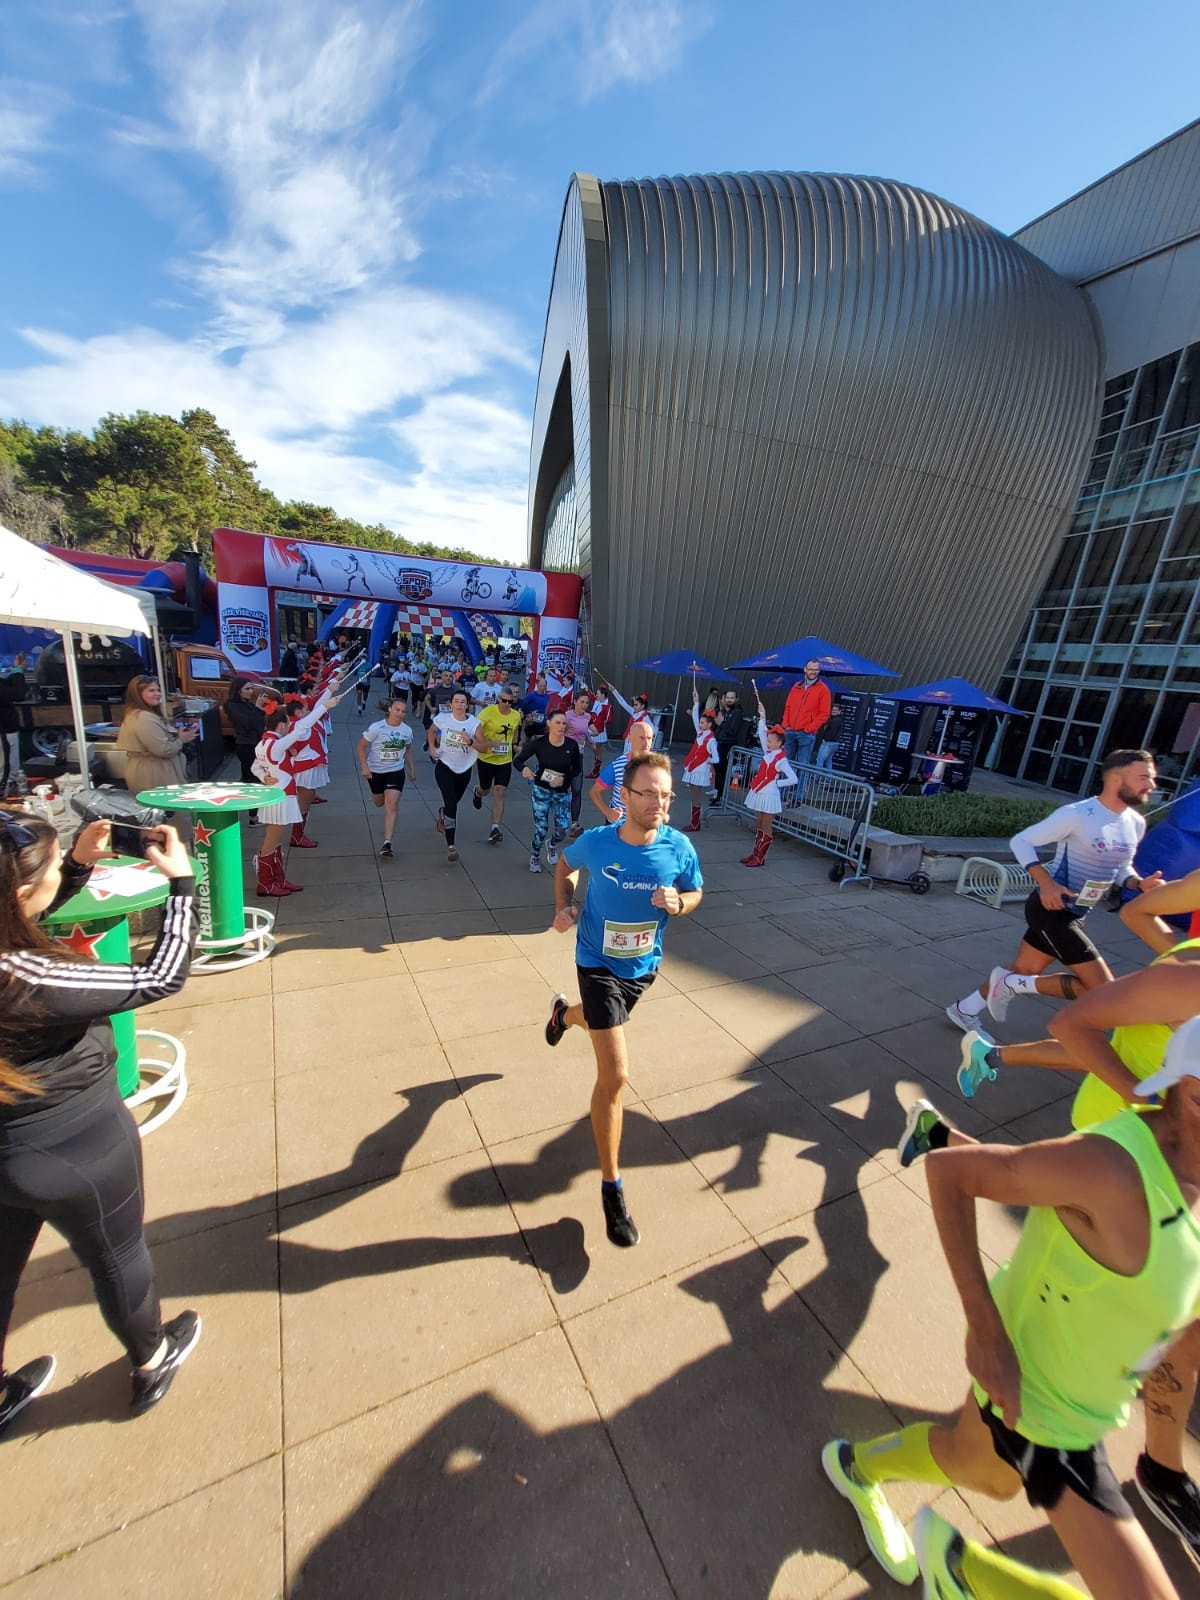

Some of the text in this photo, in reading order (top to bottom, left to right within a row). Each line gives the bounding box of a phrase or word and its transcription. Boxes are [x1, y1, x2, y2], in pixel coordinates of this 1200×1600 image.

[402, 577, 433, 588] SPORT
[399, 585, 423, 593] FEST
[228, 625, 267, 638] SPORT
[225, 635, 257, 646] FEST
[546, 653, 574, 663] SPORT
[622, 881, 658, 892] OSMINA
[634, 932, 650, 946] 15
